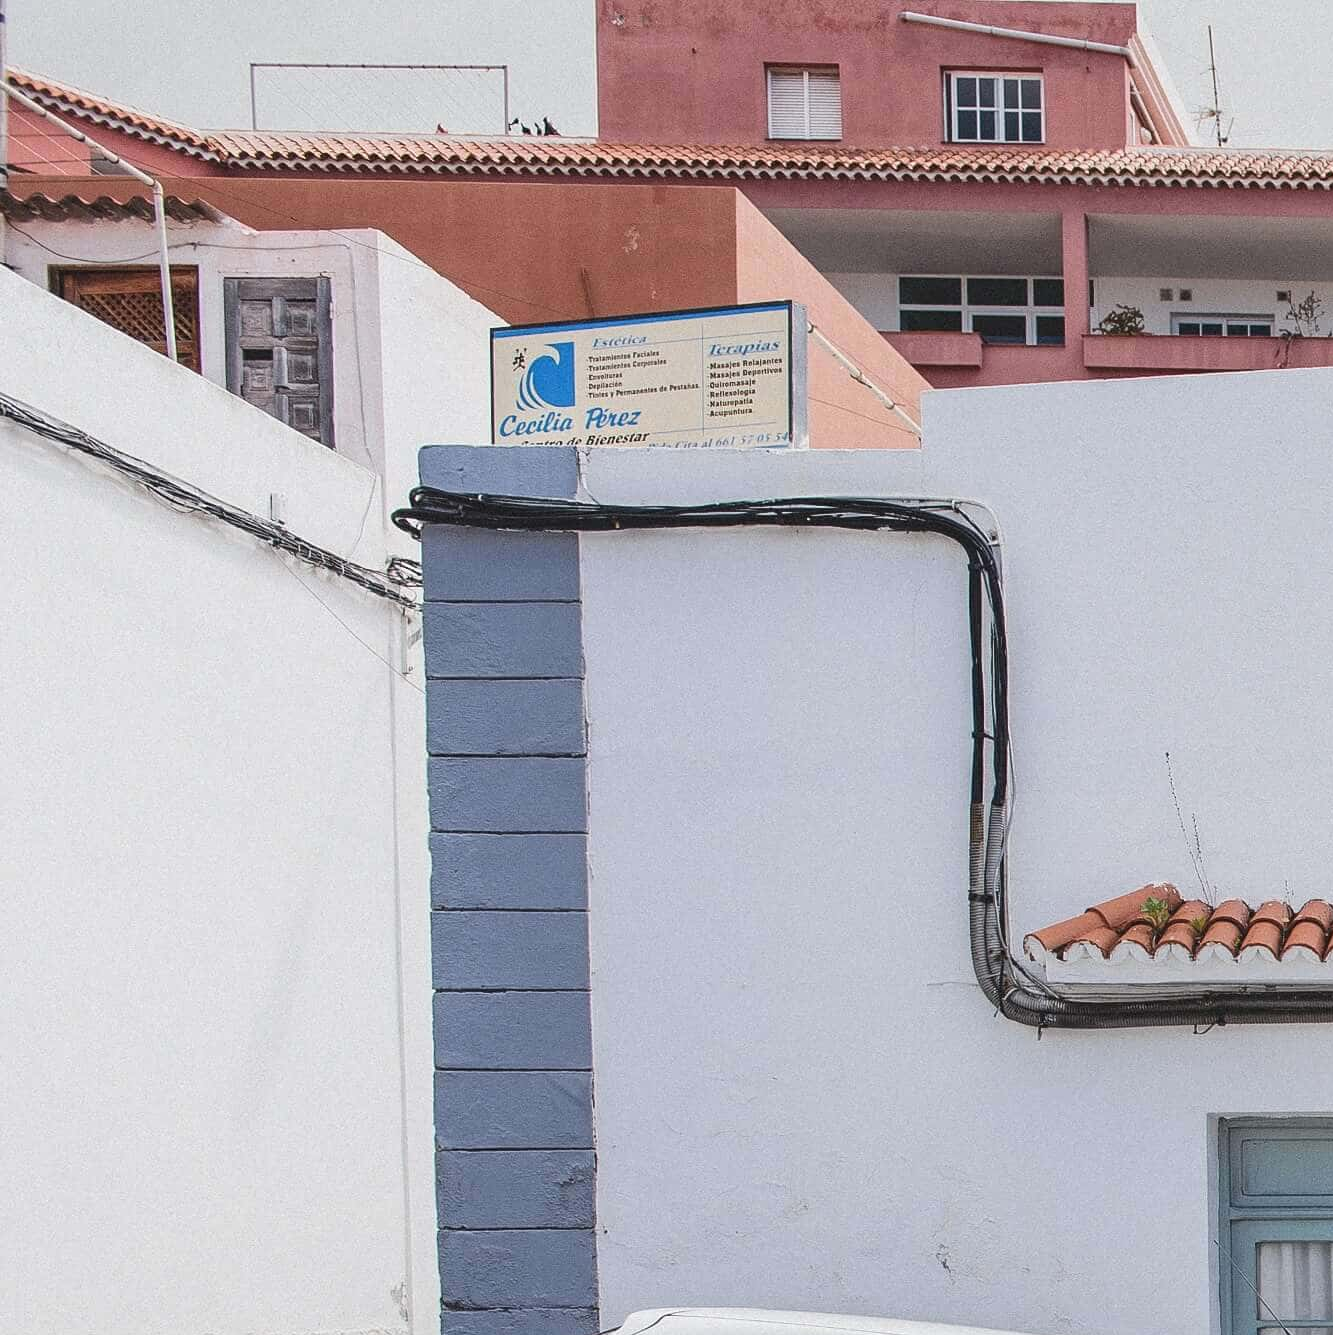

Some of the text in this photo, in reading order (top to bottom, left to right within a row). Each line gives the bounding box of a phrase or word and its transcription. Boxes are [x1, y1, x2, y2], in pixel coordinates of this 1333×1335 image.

[708, 341, 781, 356] Terapias
[588, 350, 660, 363] Tratamientos Faciales
[588, 359, 667, 372] Tratamientos Corporales
[710, 358, 783, 370] Masajes Relajantes
[588, 372, 623, 381] Envolturas
[710, 367, 783, 379] Masajes Deportivos
[710, 379, 756, 389] Quiromasaje
[616, 386, 658, 397] Permanentes
[659, 385, 668, 393] de
[710, 408, 753, 418] Acupuntura
[500, 407, 642, 437] Cecilia Pérez
[585, 433, 650, 447] Bienestar
